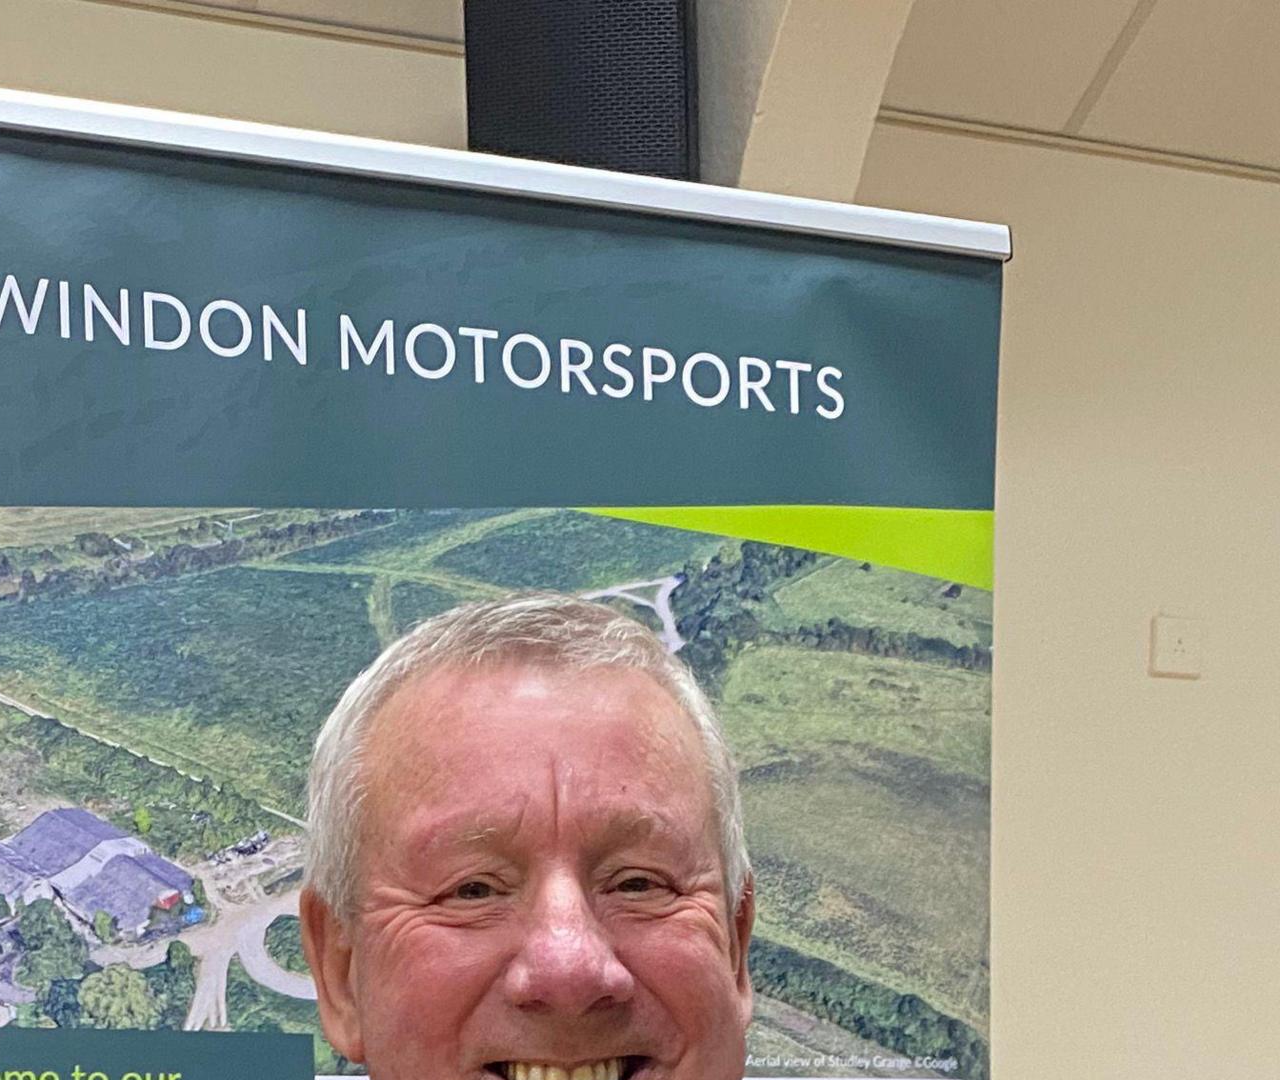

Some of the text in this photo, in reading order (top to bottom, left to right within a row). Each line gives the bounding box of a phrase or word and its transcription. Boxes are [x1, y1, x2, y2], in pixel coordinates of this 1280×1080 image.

[339, 313, 846, 421] MOTORSPORTS
[745, 1055, 780, 1067] Aerial
[784, 1055, 810, 1067] view
[814, 1055, 825, 1067] of
[828, 1055, 870, 1069] Studley
[873, 1056, 912, 1070] Grange
